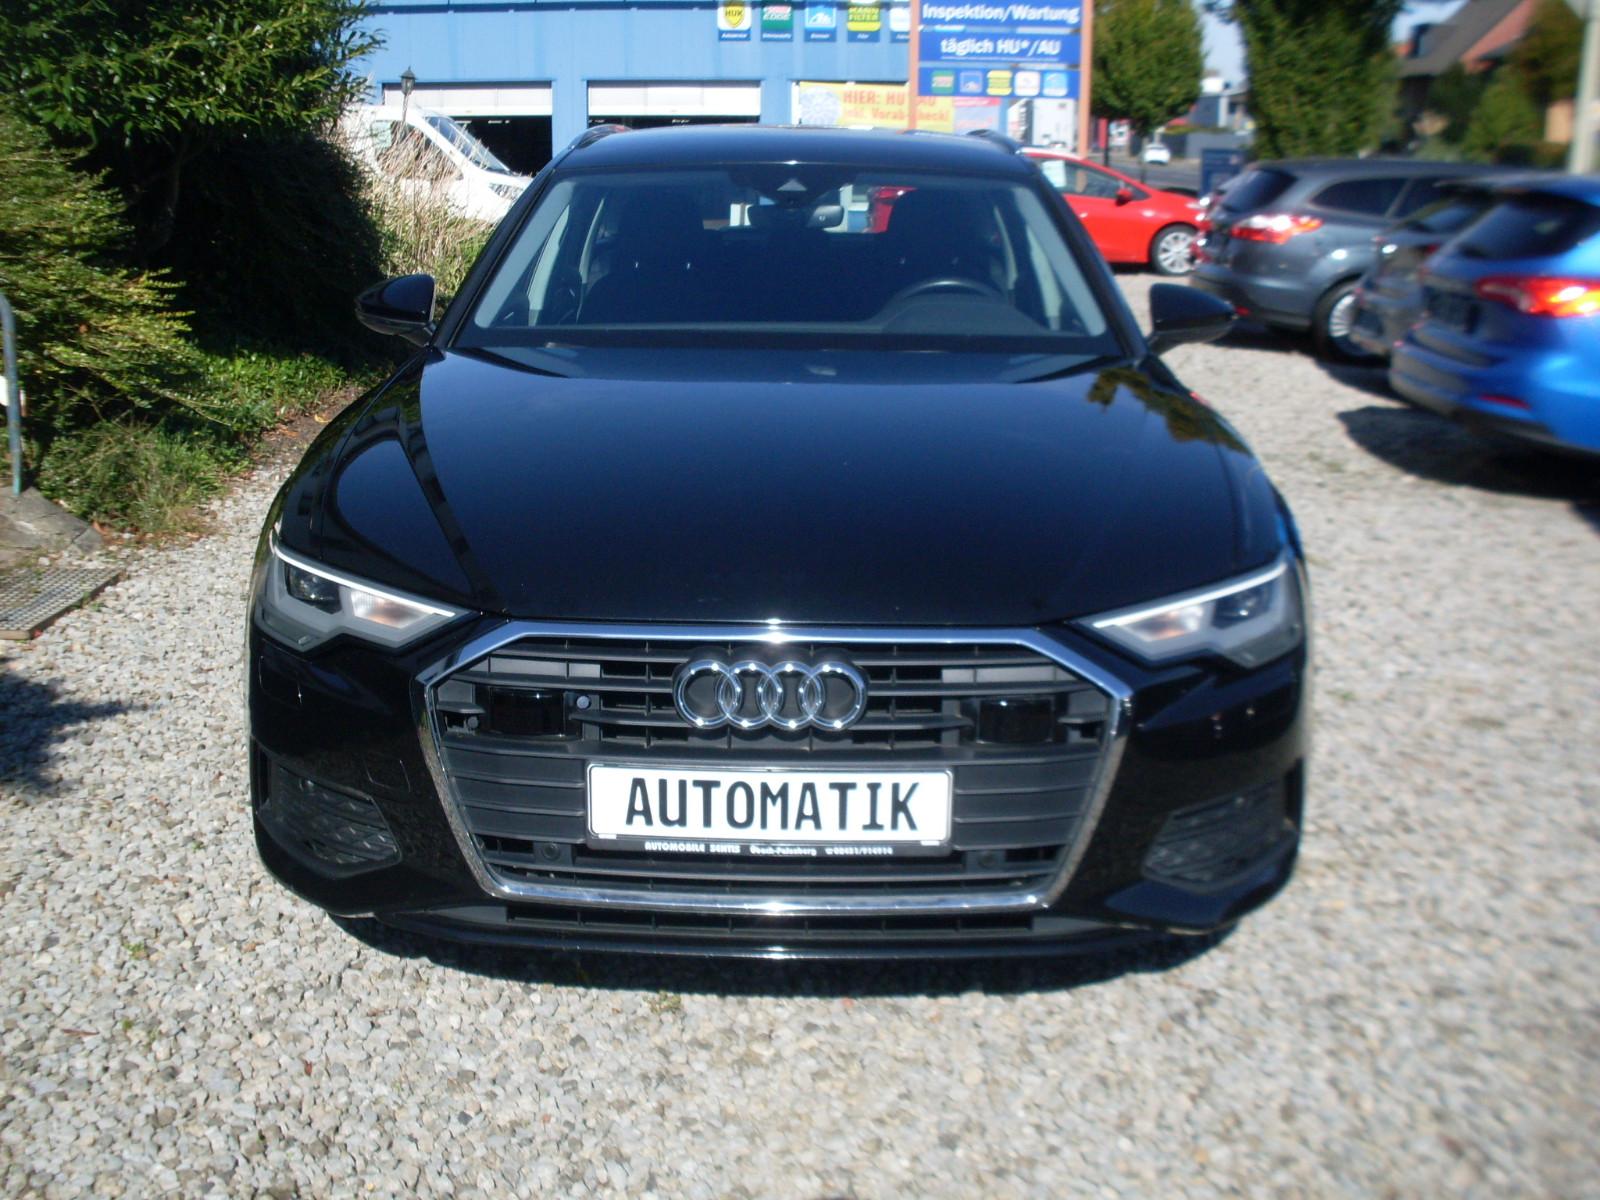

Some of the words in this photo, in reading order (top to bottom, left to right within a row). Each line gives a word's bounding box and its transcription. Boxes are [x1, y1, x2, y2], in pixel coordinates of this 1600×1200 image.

[725, 9, 743, 17] HUK
[922, 3, 1080, 25] Inspektion/Wartung
[940, 37, 994, 56] täglich
[843, 90, 881, 105] HIER:
[626, 777, 921, 831] AUTOMATIK
[644, 840, 706, 853] AUTOMOBILE
